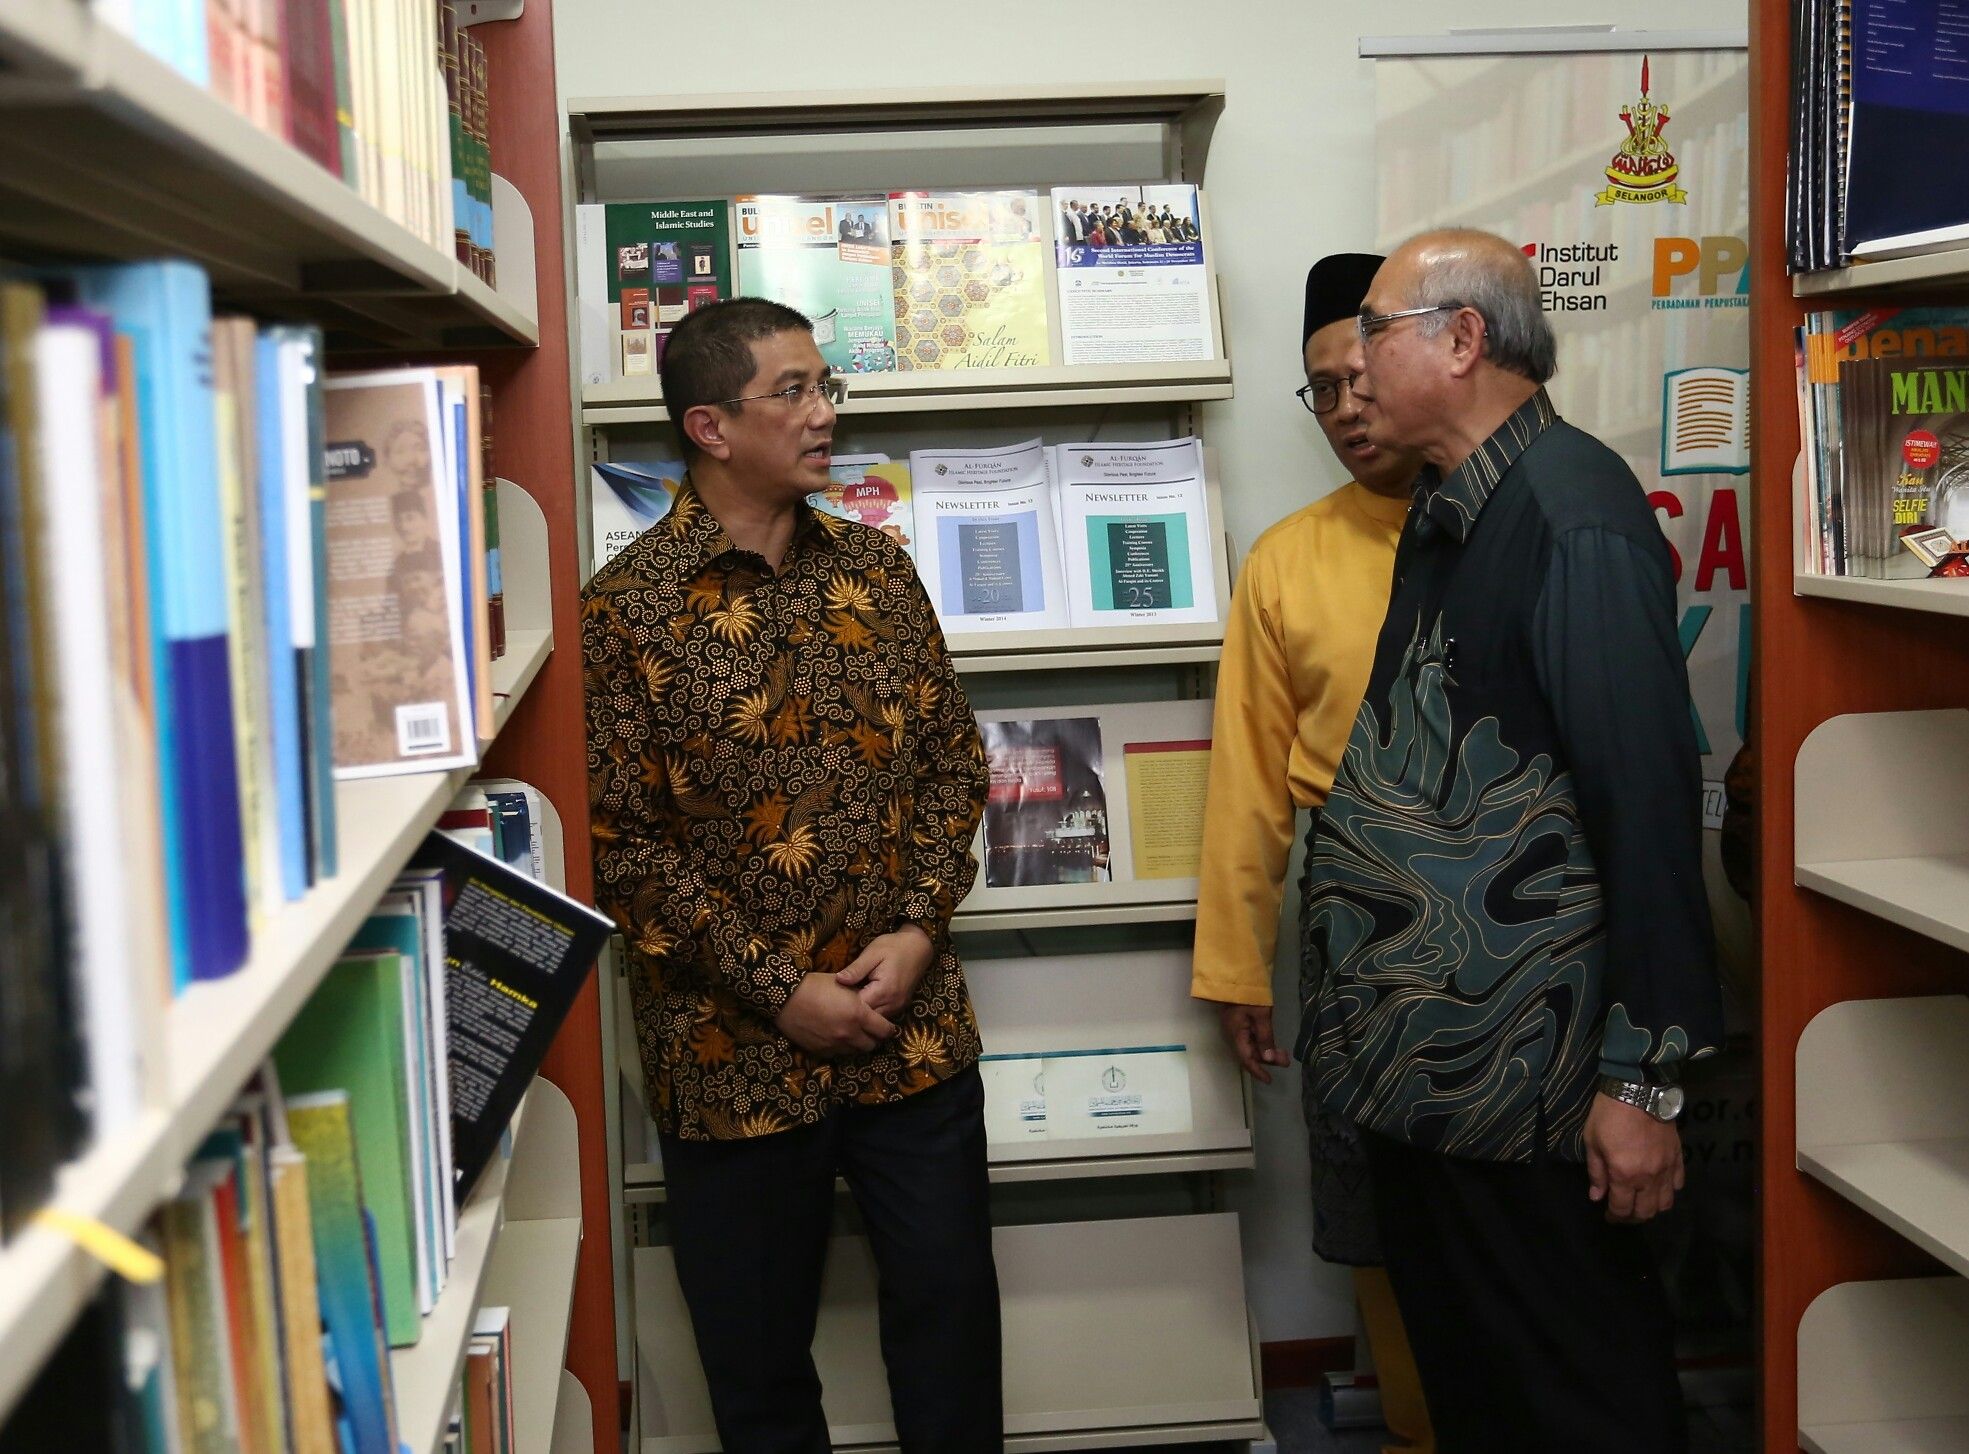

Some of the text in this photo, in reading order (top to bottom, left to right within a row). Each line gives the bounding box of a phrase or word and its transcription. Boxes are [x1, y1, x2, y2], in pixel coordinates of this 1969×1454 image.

[1615, 189, 1668, 201] SELANGOR
[651, 209, 714, 219] Middle East and
[655, 220, 715, 230] Islamic Studies
[1540, 242, 1618, 263] Institut
[1540, 266, 1600, 287] Darul
[1540, 291, 1607, 311] Ehsan
[1651, 297, 1750, 310] PERBADANAN PERPUSTAK
[973, 324, 1018, 346] Salam
[954, 346, 1039, 370] Aidil Fitri
[856, 487, 880, 498] MPH
[1085, 493, 1149, 502] NEWSLETTER
[935, 501, 1000, 510] NEWSLETTER
[1892, 498, 1928, 512] SELFIE
[1895, 511, 1918, 524] DIRI
[606, 531, 644, 541] ASEAN
[1128, 587, 1154, 608] 25
